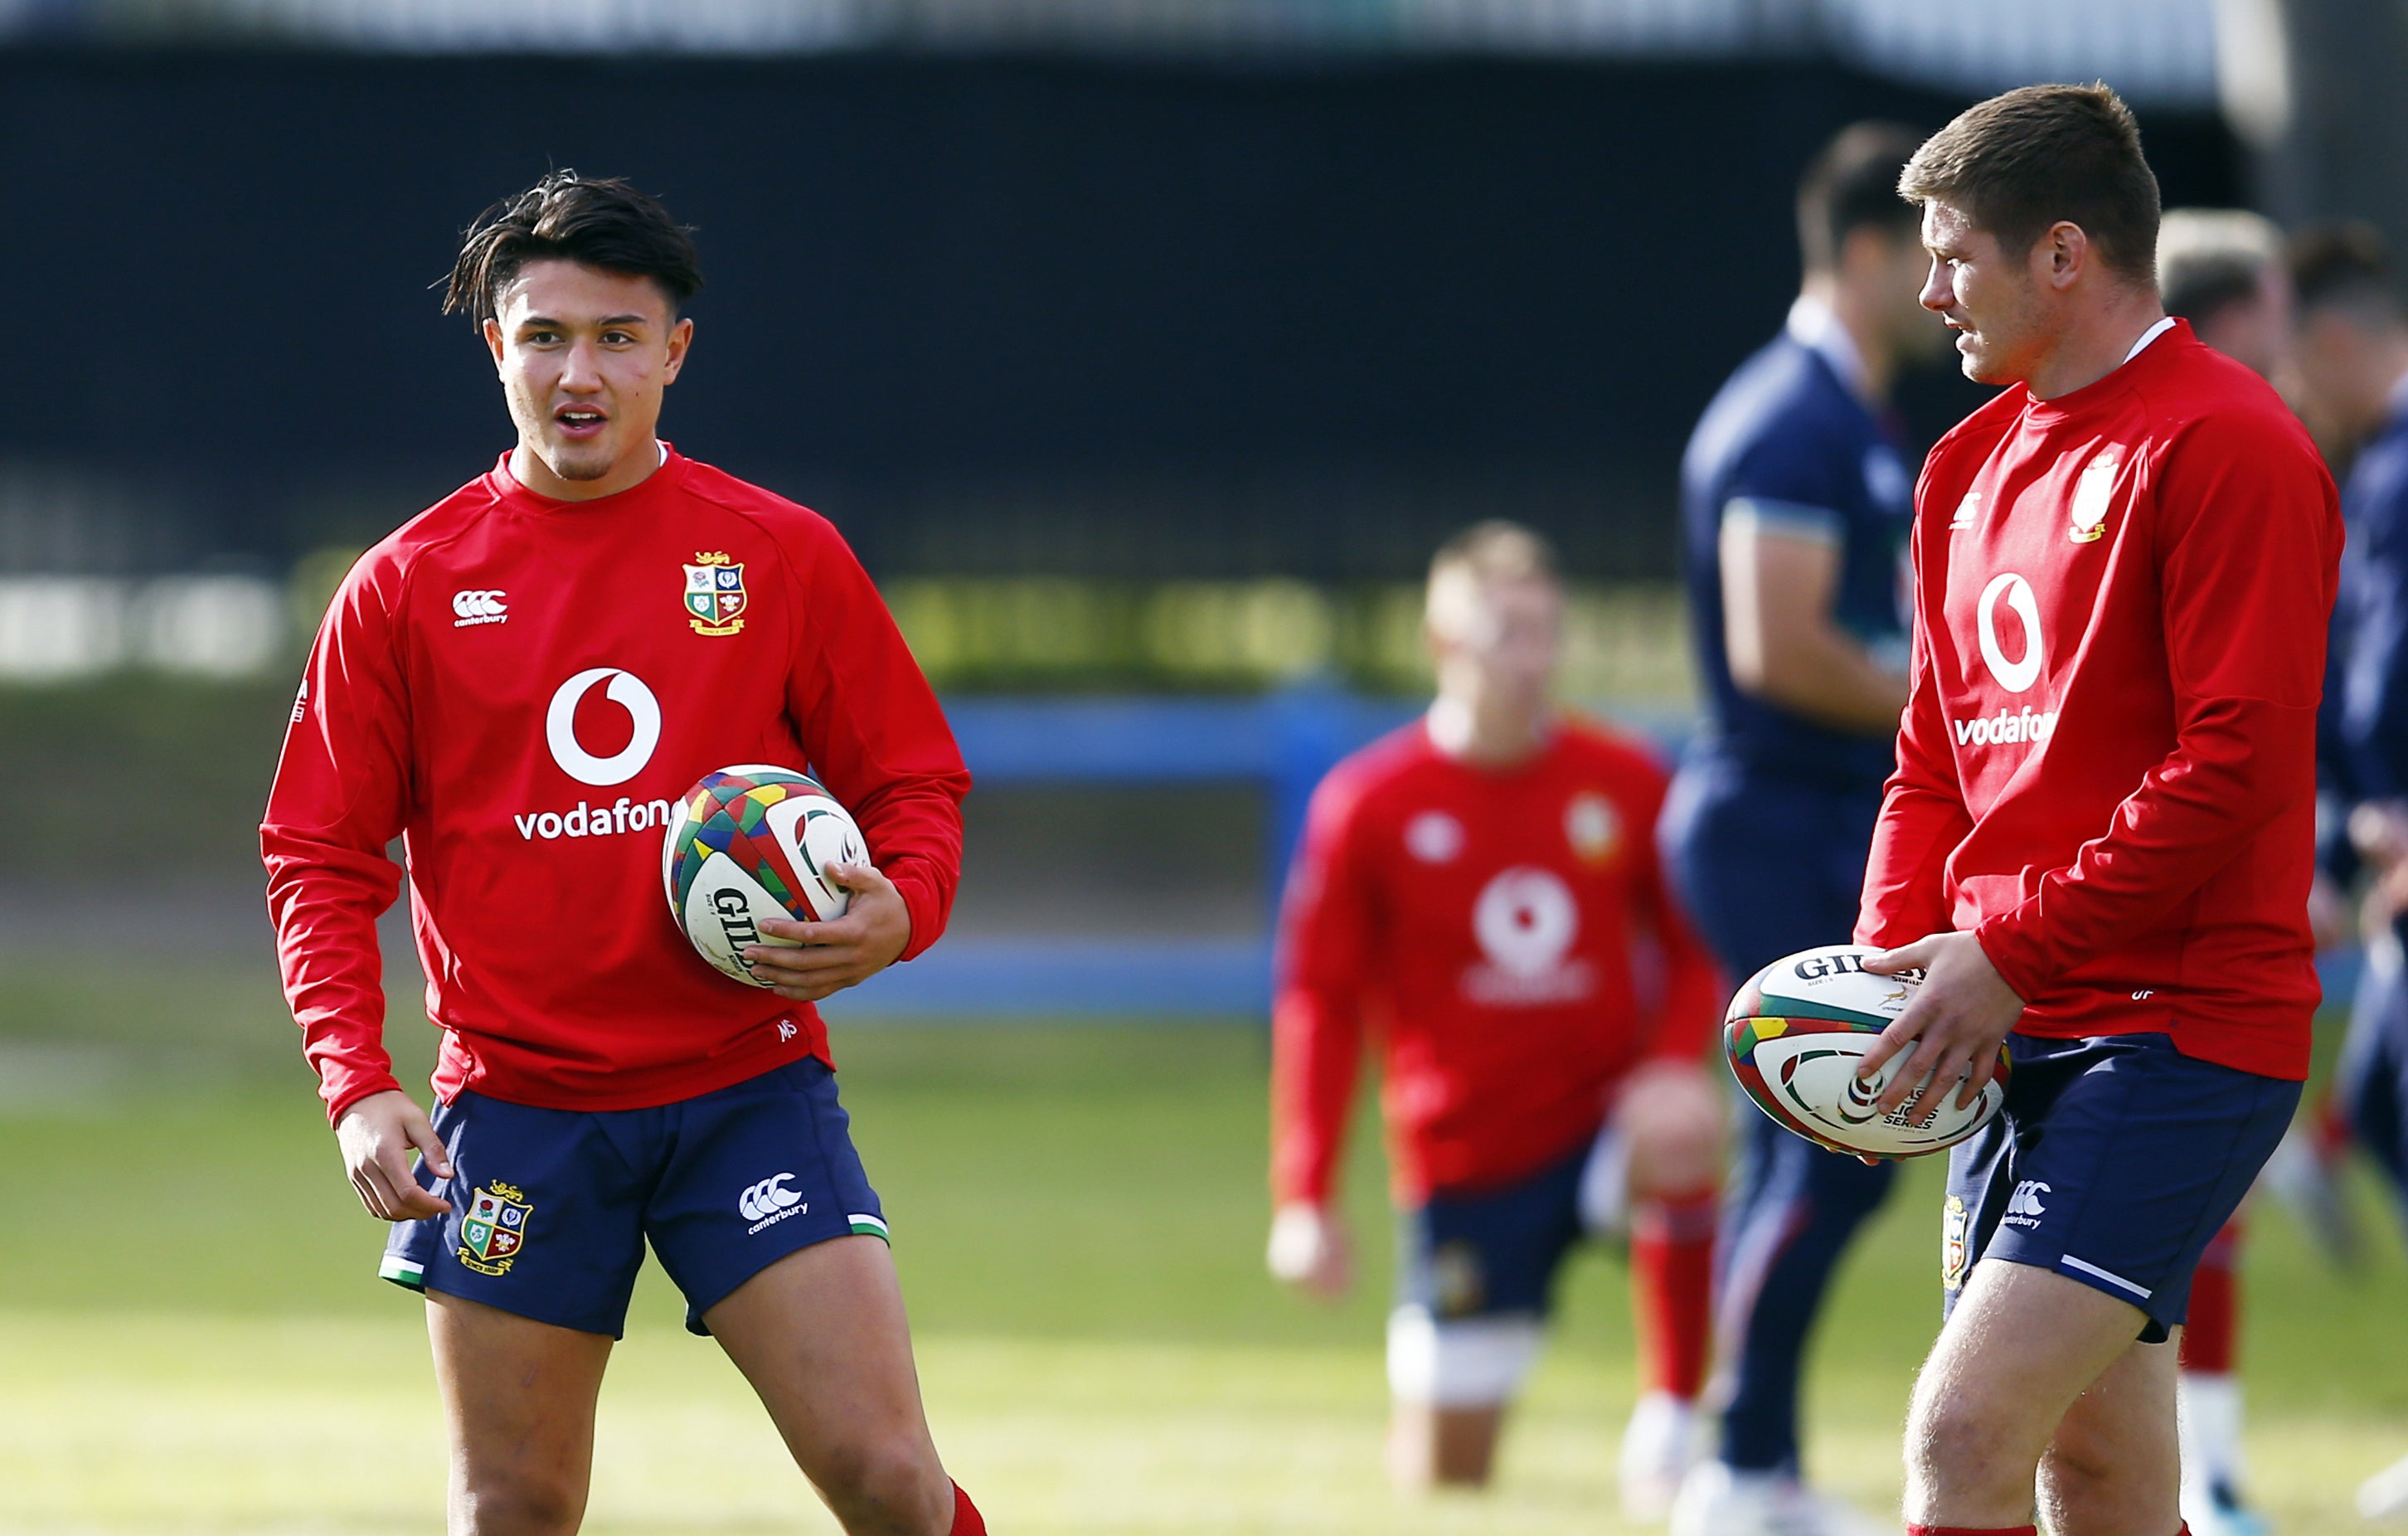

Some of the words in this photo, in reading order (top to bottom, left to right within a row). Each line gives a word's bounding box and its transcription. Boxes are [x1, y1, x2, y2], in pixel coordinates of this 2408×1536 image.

[454, 615, 508, 628] canterbury
[513, 797, 679, 840] vodafon
[748, 1203, 808, 1236] canterbury
